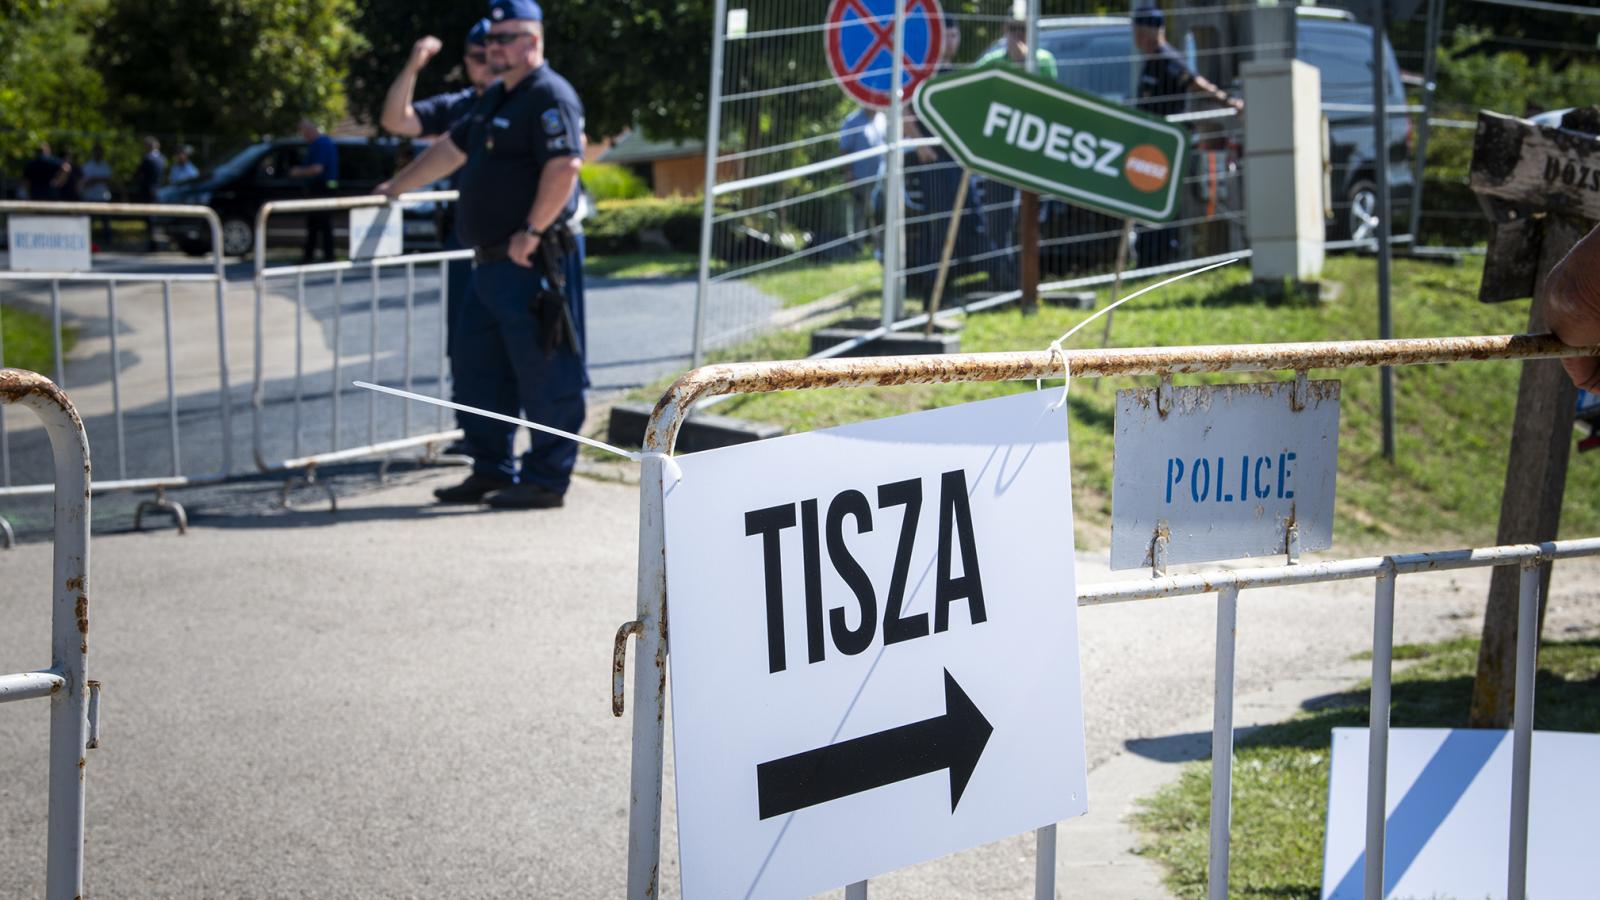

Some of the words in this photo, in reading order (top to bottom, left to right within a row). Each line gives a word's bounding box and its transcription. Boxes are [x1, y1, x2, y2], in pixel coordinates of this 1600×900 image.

[983, 102, 1125, 178] FIDESZ
[1165, 452, 1297, 504] POLICE
[744, 469, 988, 674] TISZA
